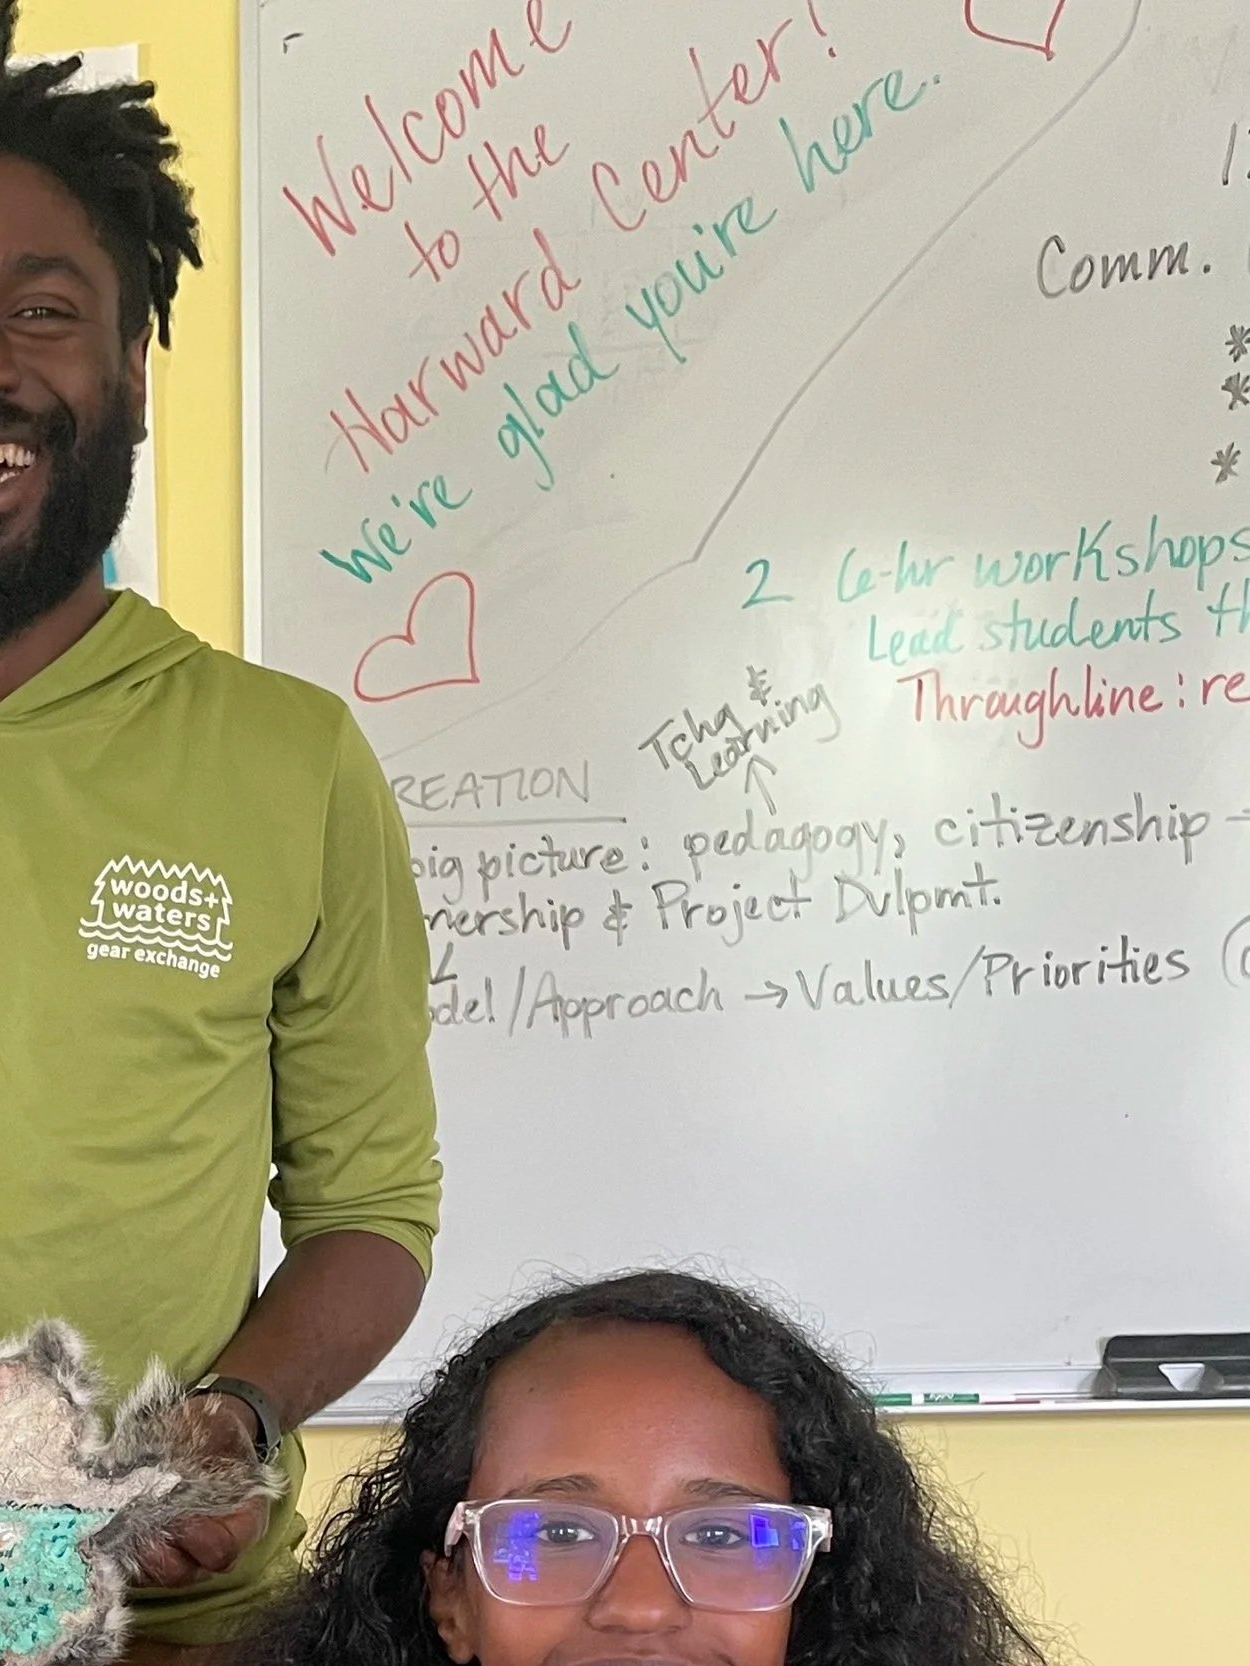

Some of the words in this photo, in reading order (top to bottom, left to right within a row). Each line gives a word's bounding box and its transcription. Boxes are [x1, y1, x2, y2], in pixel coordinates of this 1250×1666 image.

[283, 0, 571, 256] Welcome
[405, 221, 460, 282] to
[468, 123, 569, 221] the
[1037, 234, 1211, 298] Comm.
[319, 474, 473, 583] We're
[497, 322, 619, 491] glad
[626, 196, 776, 363] you're
[779, 69, 941, 193] here.
[328, 227, 581, 473] Harward
[741, 558, 795, 609] 2
[868, 607, 963, 666] Lead
[978, 588, 1182, 652] students
[934, 791, 1210, 865] citizenship
[112, 902, 211, 931] waters
[652, 868, 811, 947] Project
[86, 943, 131, 960] gear
[134, 948, 221, 979] exchange
